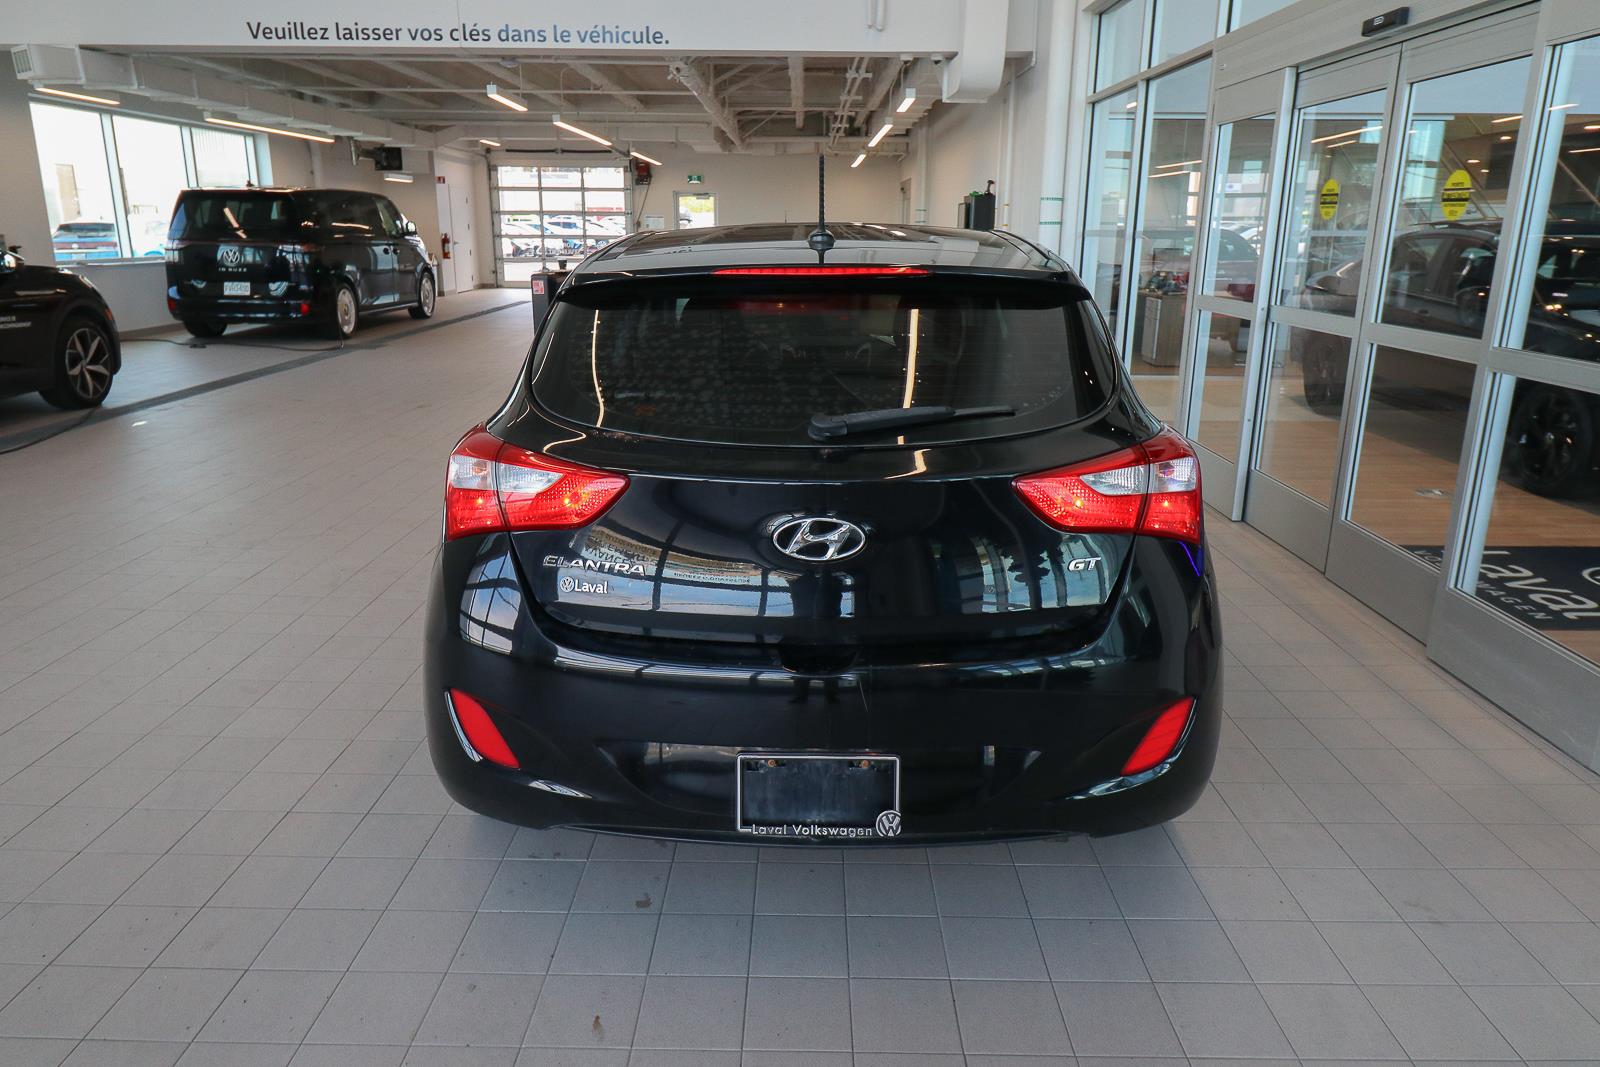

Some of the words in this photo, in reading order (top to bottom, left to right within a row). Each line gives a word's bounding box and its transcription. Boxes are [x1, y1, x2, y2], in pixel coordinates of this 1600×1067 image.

[246, 21, 329, 40] Veuillez
[335, 22, 402, 41] laisser
[407, 27, 443, 42] vos
[449, 23, 491, 42] clés
[497, 24, 547, 43] dans
[553, 25, 571, 43] le
[576, 24, 670, 45] véhicule.
[542, 555, 645, 576] ELANTRA
[1068, 557, 1102, 571] GT
[575, 579, 608, 594] Laval
[752, 824, 787, 835] Laval
[792, 824, 873, 838] Volkswagen
